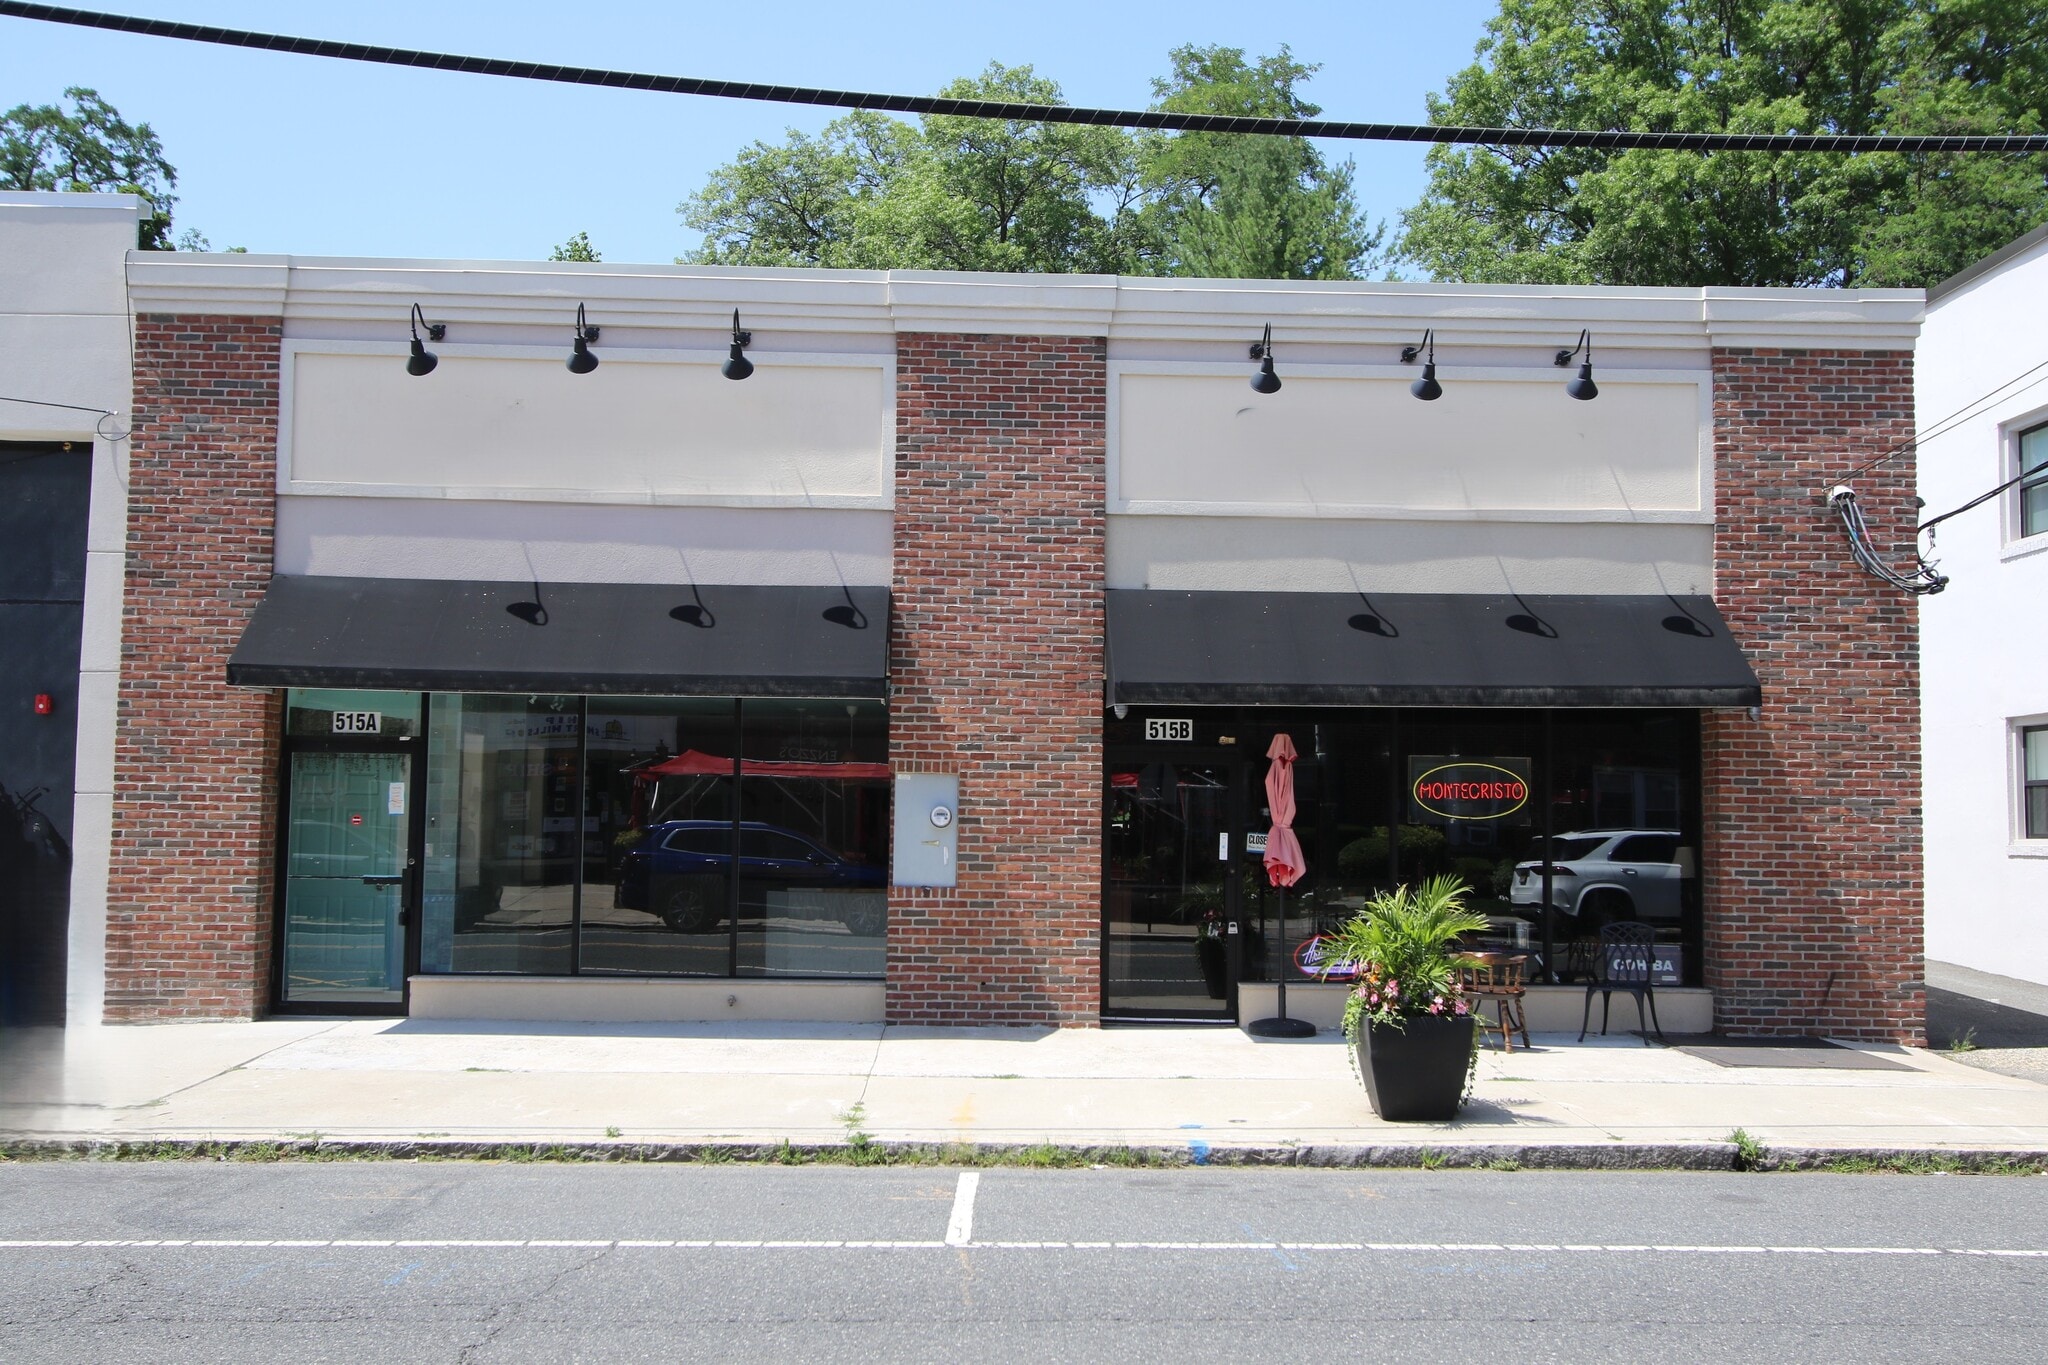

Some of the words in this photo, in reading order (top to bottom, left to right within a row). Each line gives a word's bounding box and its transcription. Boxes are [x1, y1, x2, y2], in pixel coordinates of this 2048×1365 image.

[336, 713, 377, 731] 515A
[1149, 721, 1190, 739] 515B
[1420, 782, 1524, 800] MONTECRISTO
[1248, 834, 1268, 846] CLOSE
[1613, 959, 1674, 972] COHBA
